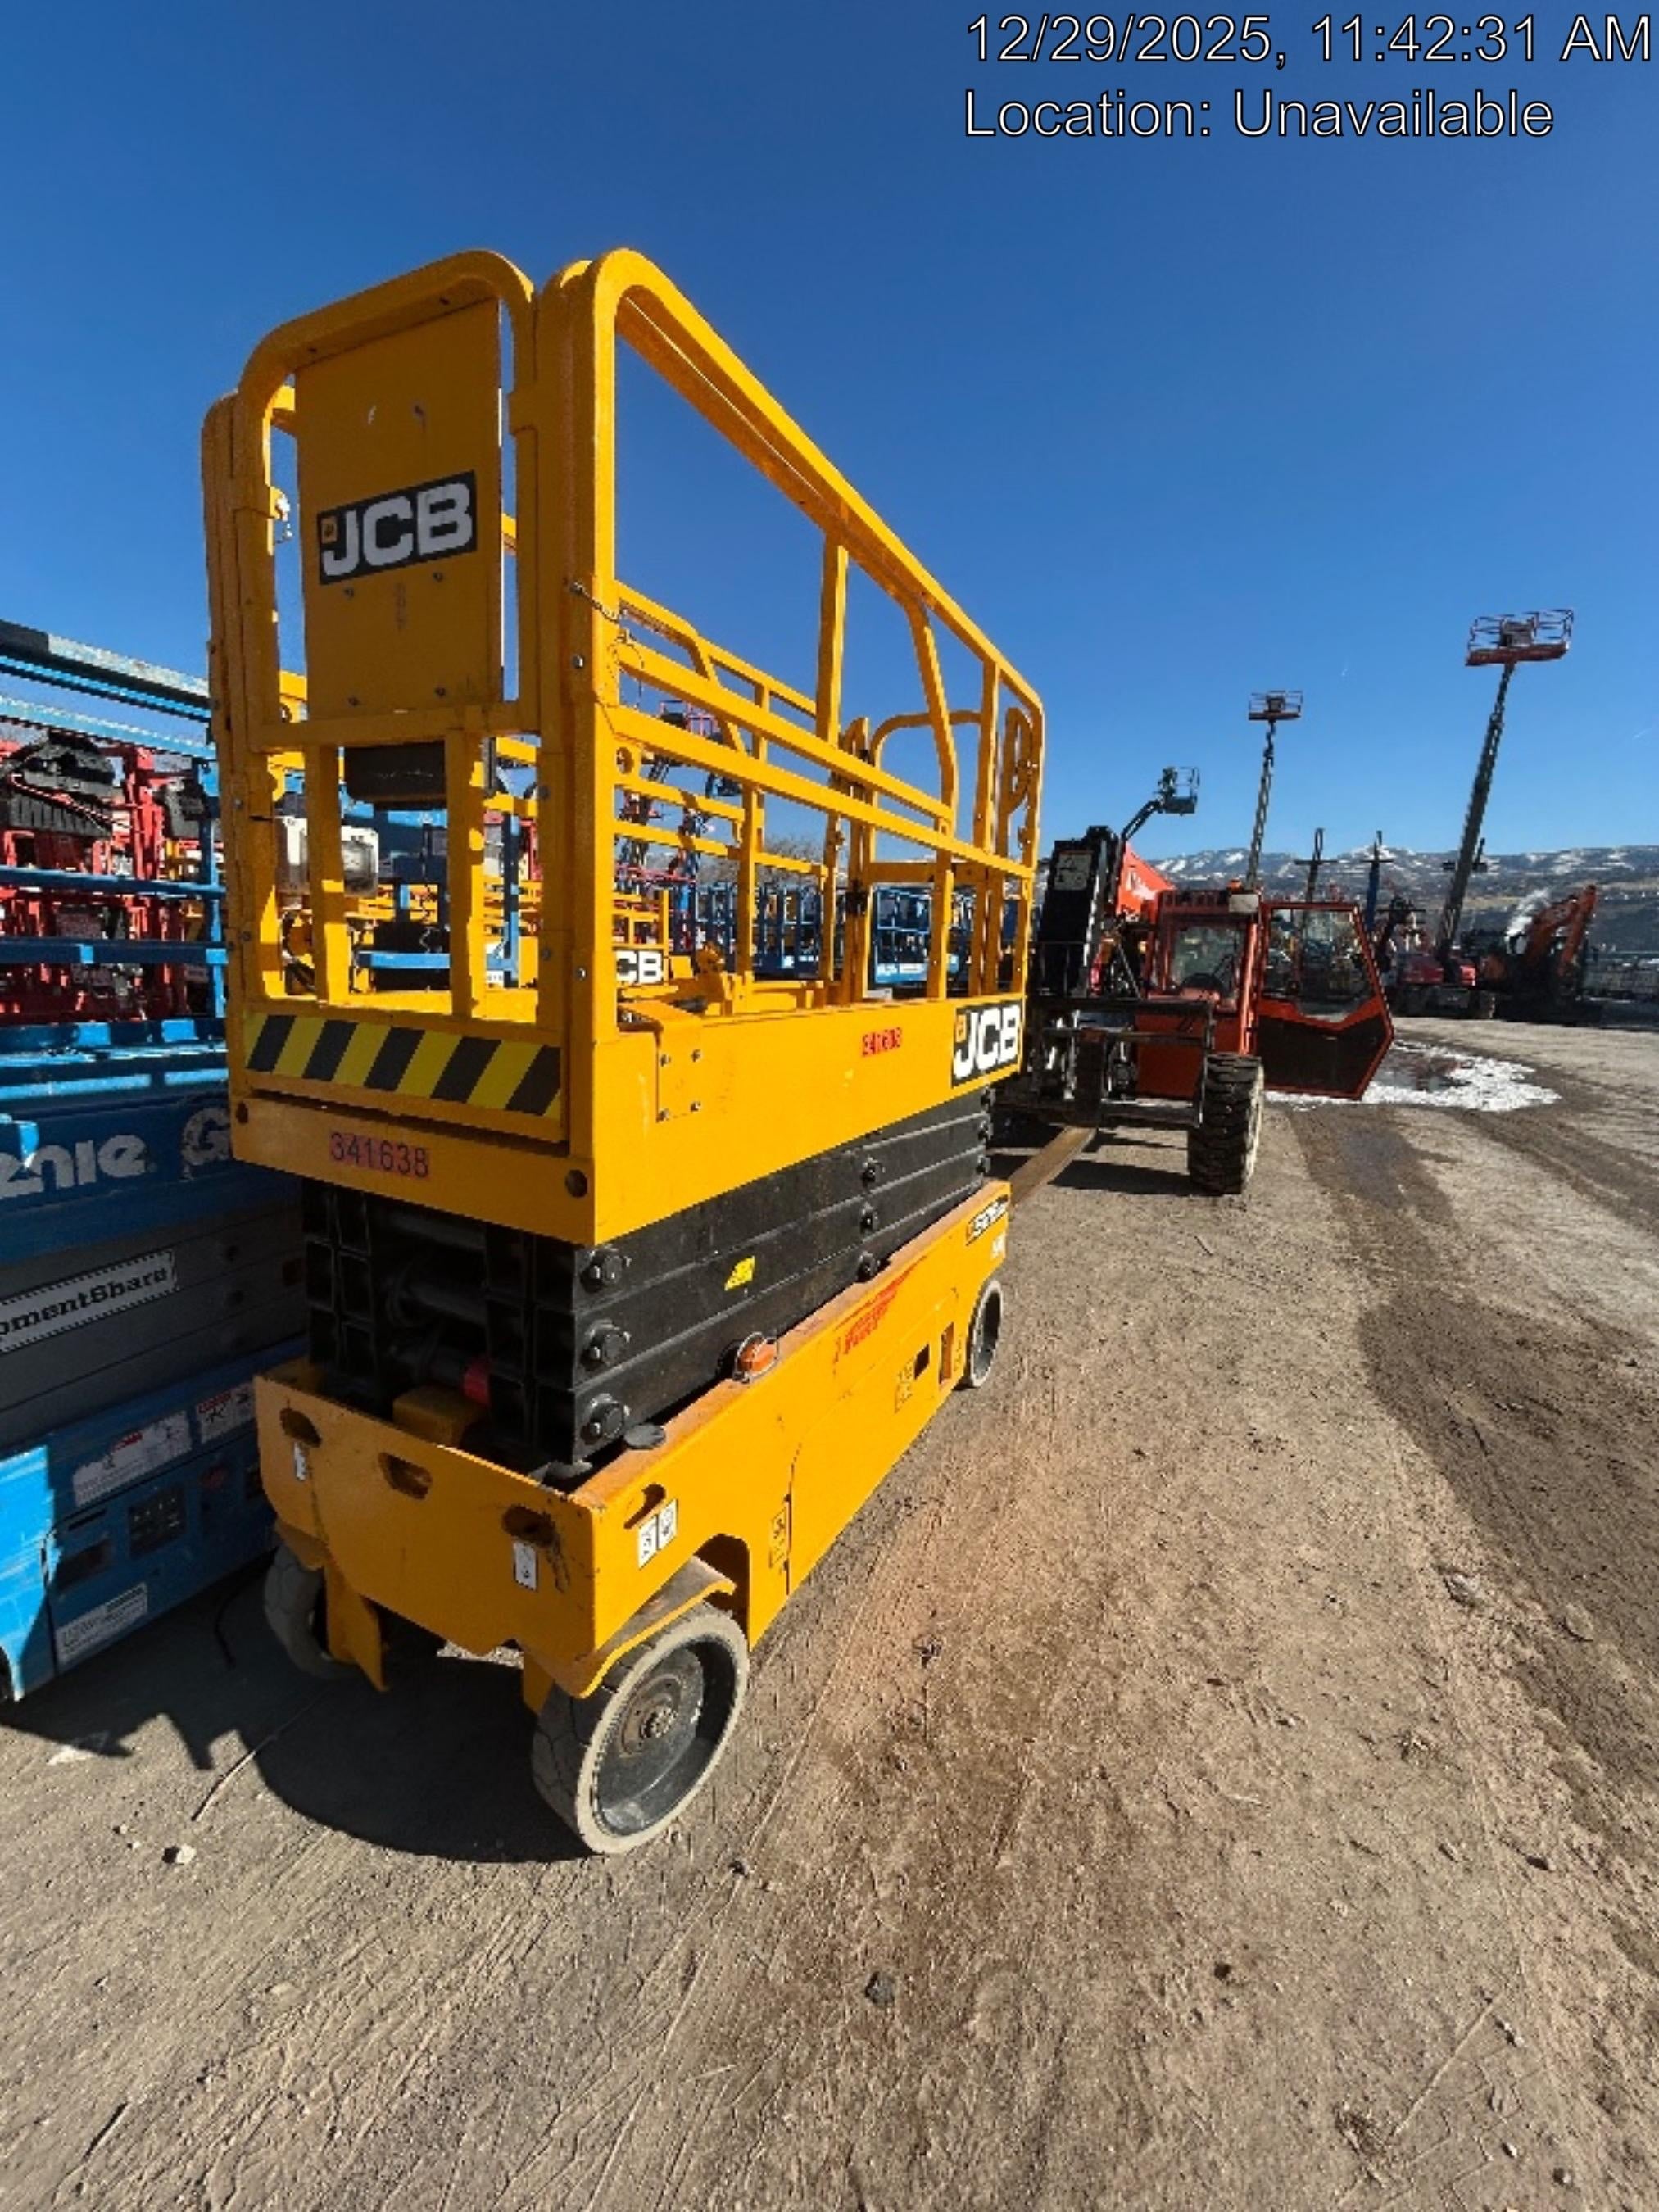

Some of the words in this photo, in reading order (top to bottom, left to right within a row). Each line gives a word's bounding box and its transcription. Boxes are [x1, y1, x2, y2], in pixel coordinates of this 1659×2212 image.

[322, 482, 473, 576] JCB
[954, 1004, 1020, 1079] JCB
[331, 1128, 429, 1178] 341638
